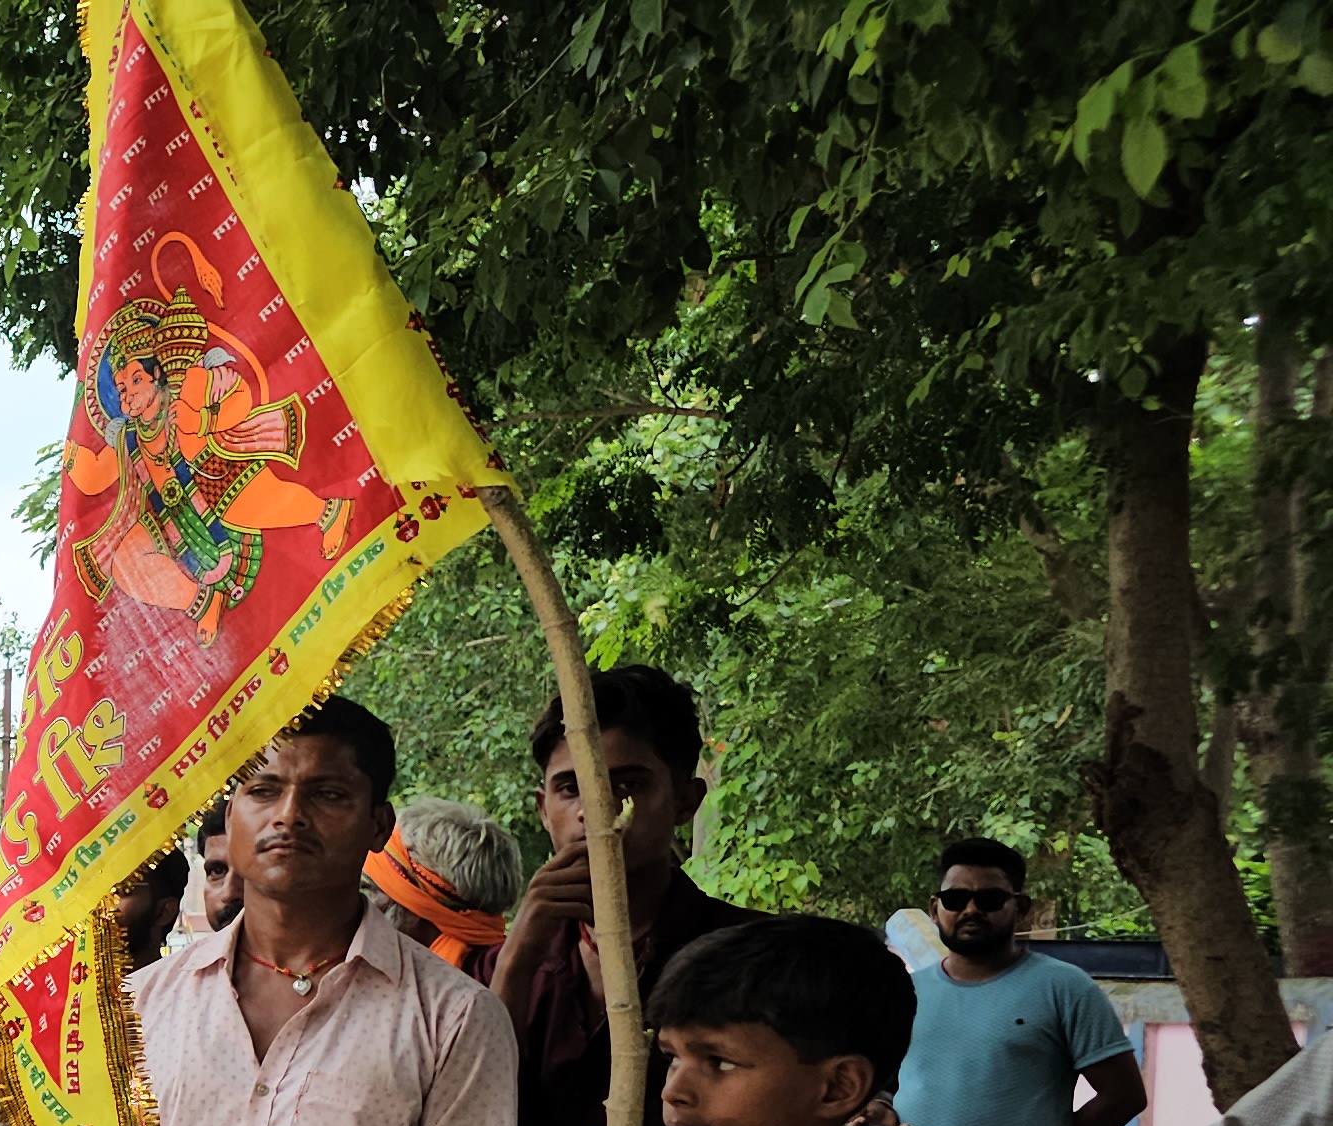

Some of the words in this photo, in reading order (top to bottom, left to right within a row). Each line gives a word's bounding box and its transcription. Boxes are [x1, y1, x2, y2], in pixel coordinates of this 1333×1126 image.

[67, 991, 82, 1026] जय
[66, 1029, 84, 1054] श्री
[30, 1064, 46, 1091] श्री
[41, 1088, 74, 1125] राम
[66, 1059, 81, 1095] राम
